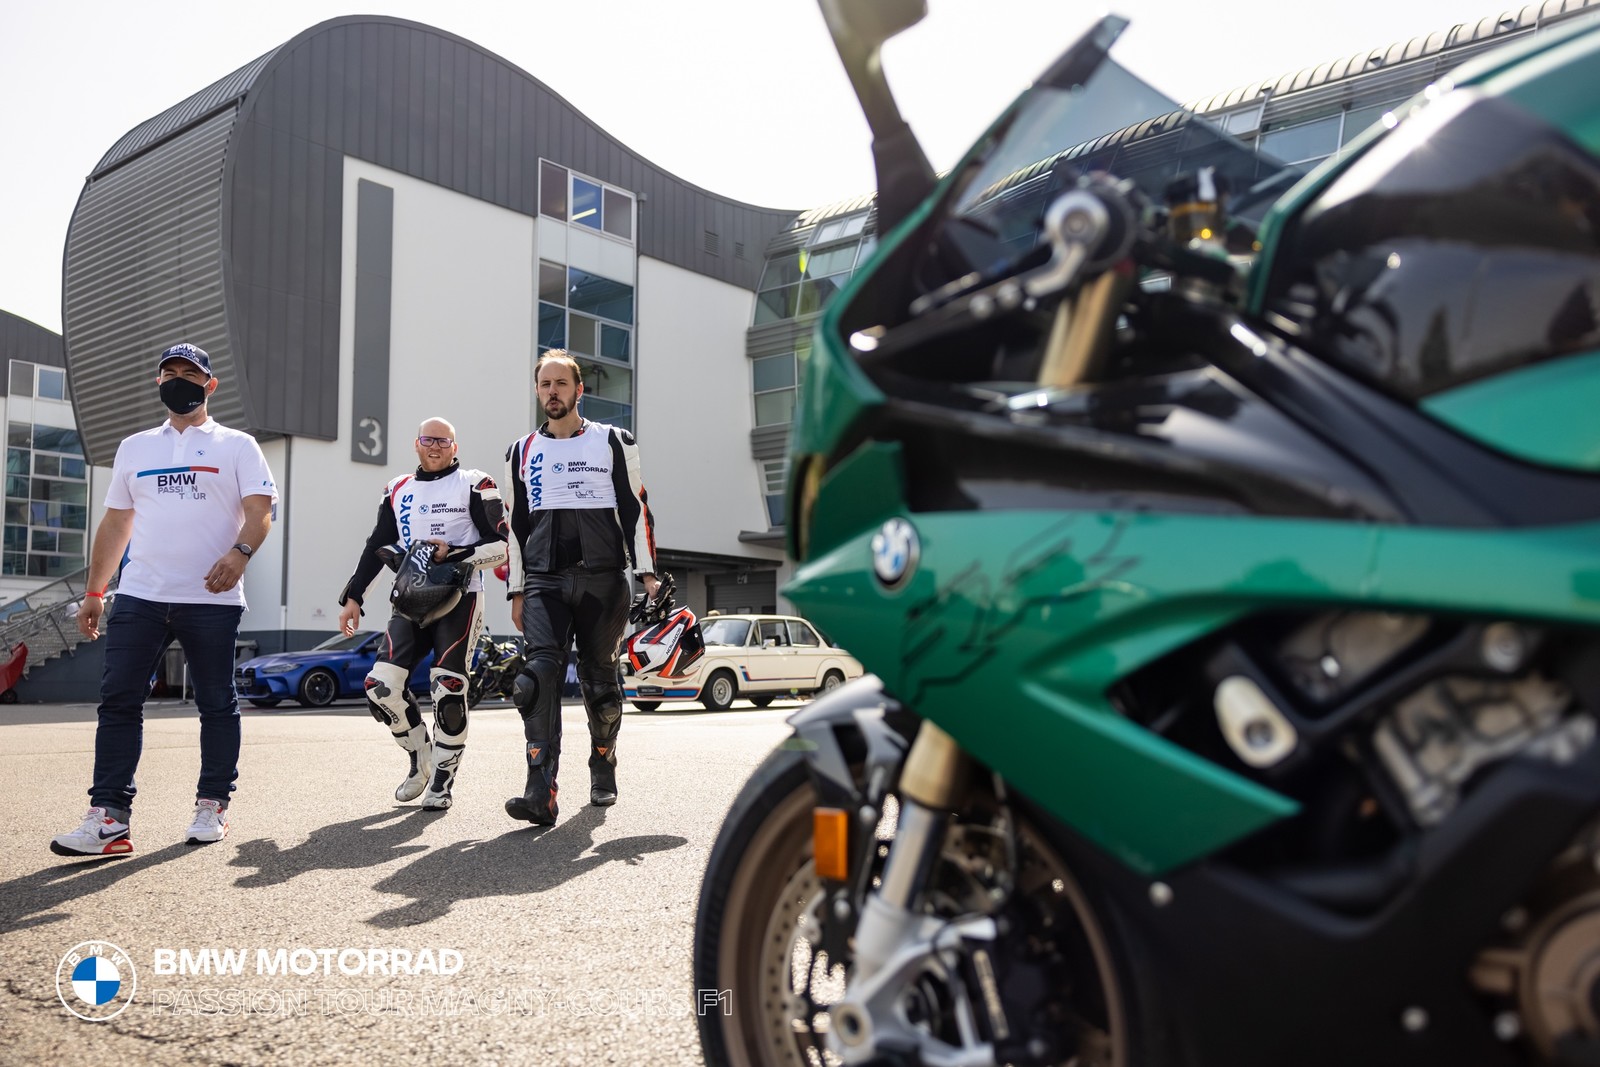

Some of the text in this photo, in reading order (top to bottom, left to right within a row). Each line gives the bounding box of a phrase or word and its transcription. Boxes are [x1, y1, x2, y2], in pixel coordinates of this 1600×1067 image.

[170, 344, 197, 352] BMW
[359, 418, 383, 457] 3
[157, 473, 197, 487] BMW
